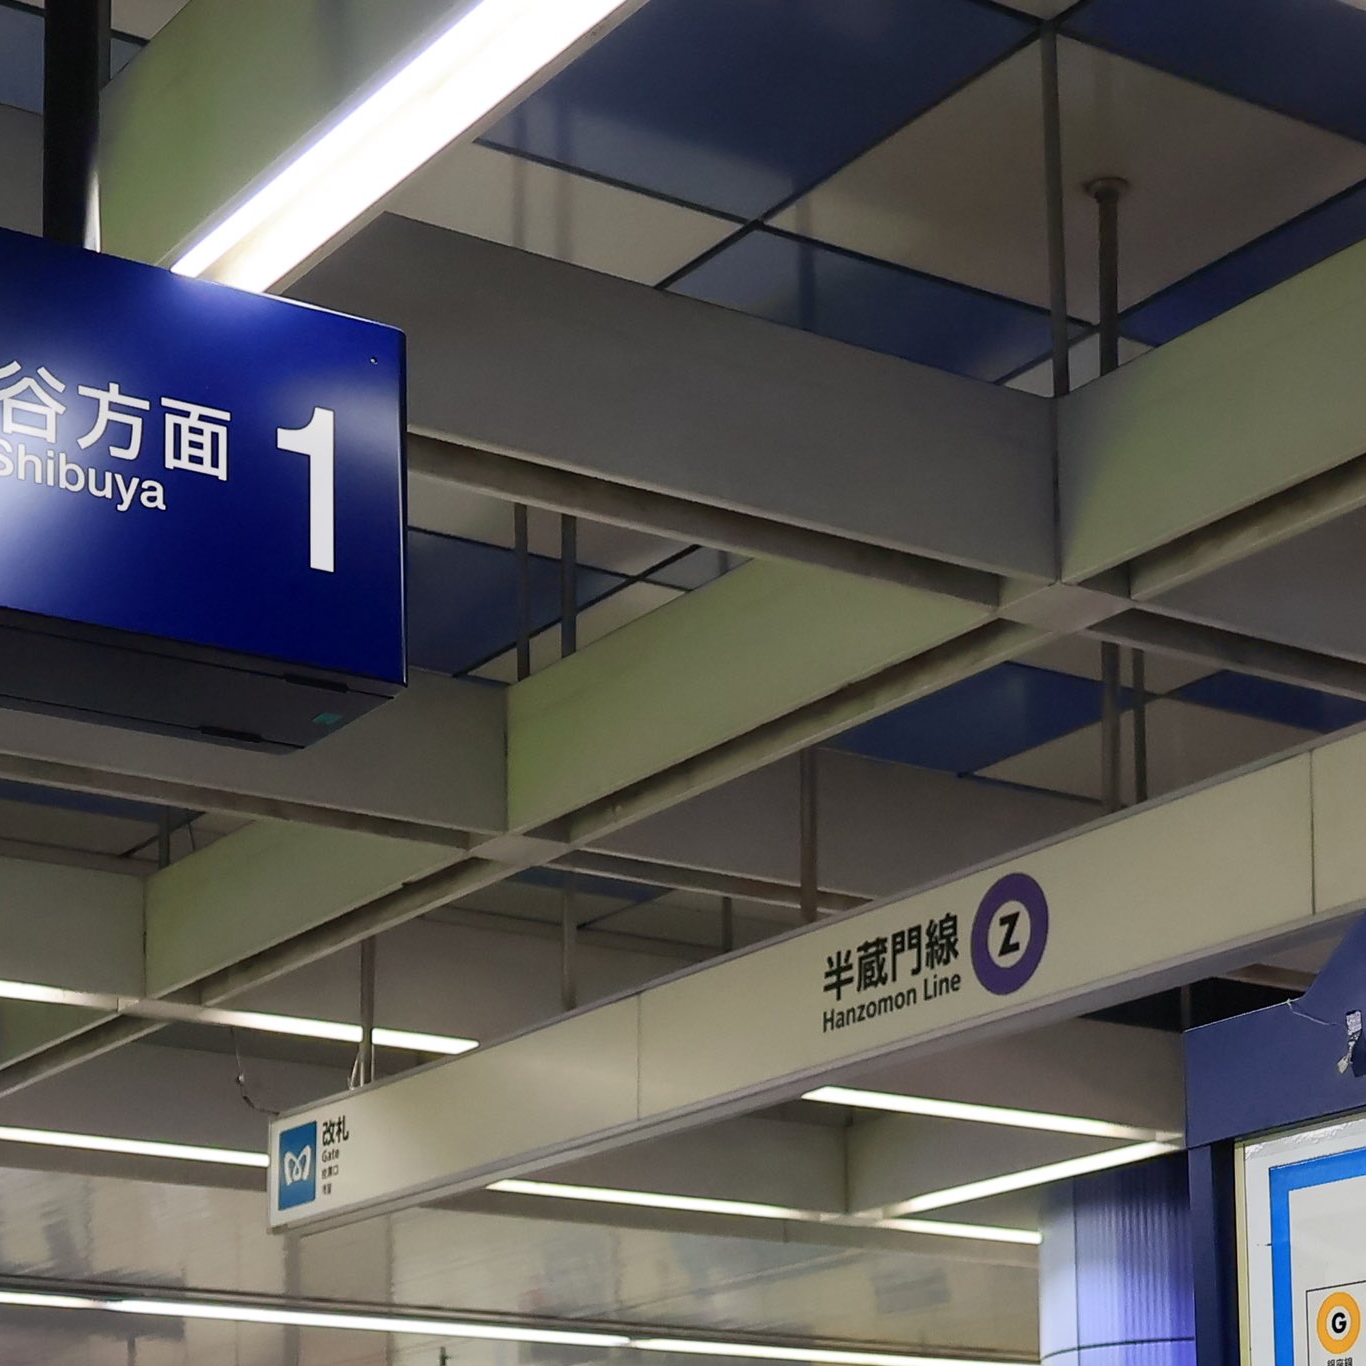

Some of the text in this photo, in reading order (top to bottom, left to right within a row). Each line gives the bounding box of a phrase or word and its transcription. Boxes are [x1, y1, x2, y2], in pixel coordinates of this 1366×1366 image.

[276, 406, 337, 575] 1
[823, 912, 959, 1001] 半蔵門線
[998, 911, 1020, 957] Z
[823, 972, 961, 1033] Hanzomon Line
[322, 1115, 349, 1146] 改札
[322, 1149, 339, 1162] Gate
[1331, 1312, 1347, 1334] G
